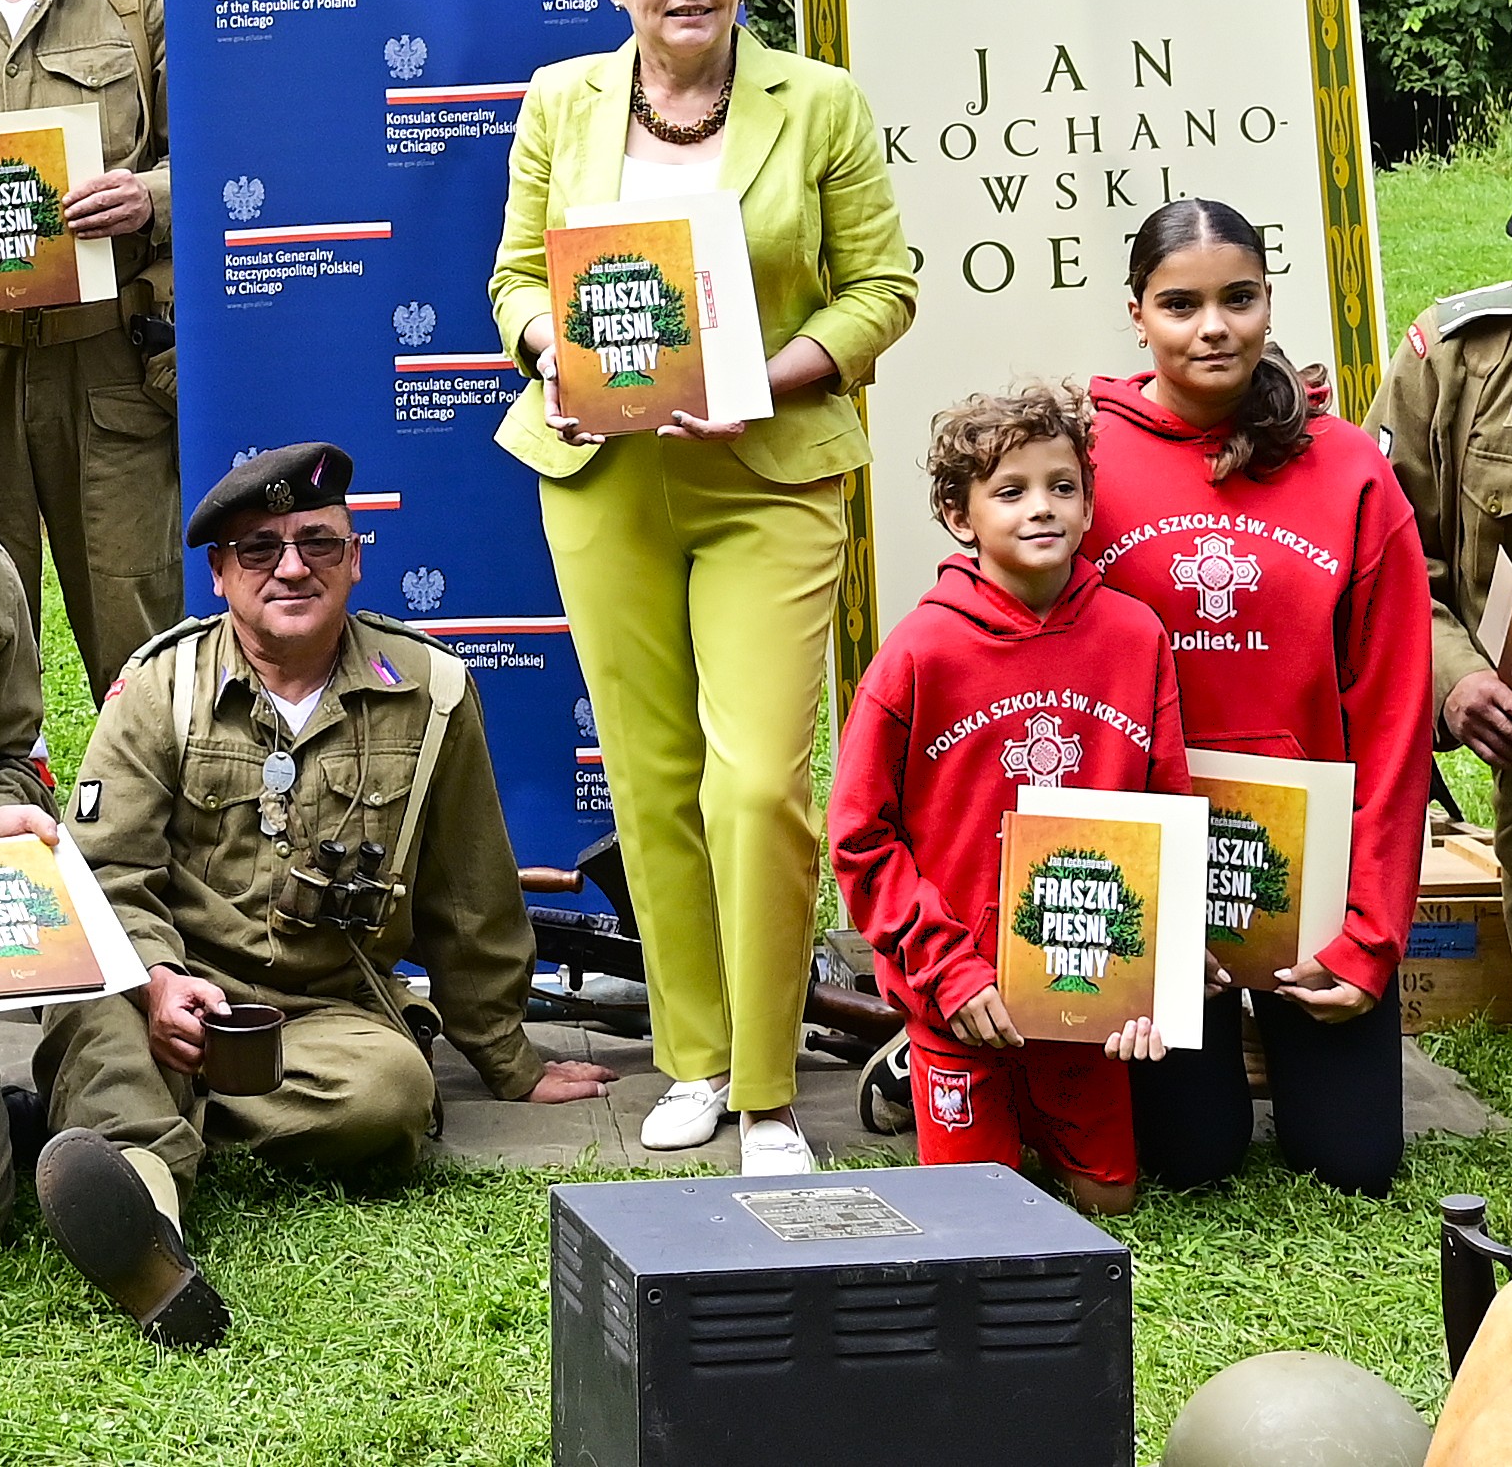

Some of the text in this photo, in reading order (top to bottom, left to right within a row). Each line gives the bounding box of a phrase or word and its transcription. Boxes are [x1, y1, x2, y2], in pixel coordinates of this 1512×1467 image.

[215, 2, 228, 15] of
[230, 1, 250, 14] the
[542, 0, 554, 11] w
[216, 14, 274, 30] in Chicago
[966, 38, 1174, 116] JAN
[386, 109, 495, 126] Konsulat Generalny
[386, 123, 480, 140] Rzeczypospolitej
[883, 106, 1289, 164] KOCHANO-
[386, 140, 446, 155] w Chicago
[225, 249, 334, 267] Konsulat Generalny
[225, 260, 364, 281] Rzeczypospolitej Polskiej
[225, 281, 283, 297] w Chicago
[597, 343, 658, 374] TRENY
[394, 376, 500, 392] Consulate General
[395, 392, 409, 407] of
[410, 392, 430, 406] the
[432, 390, 482, 407] Republic
[484, 390, 496, 404] of
[395, 406, 455, 422] in Chicago
[1095, 513, 1340, 576] POLSKA SZKOŁA ŚW. KRZYŻA
[456, 640, 515, 657] Generalny
[1170, 630, 1269, 652] Joliet, IL
[501, 654, 545, 670] Polskiej
[925, 688, 1154, 760] POLSKA SZKOŁA ŚW. KRZYŻA
[576, 784, 589, 797] of
[576, 798, 588, 811] in
[1043, 945, 1109, 978] TRENY
[932, 1074, 966, 1087] POLSKA
